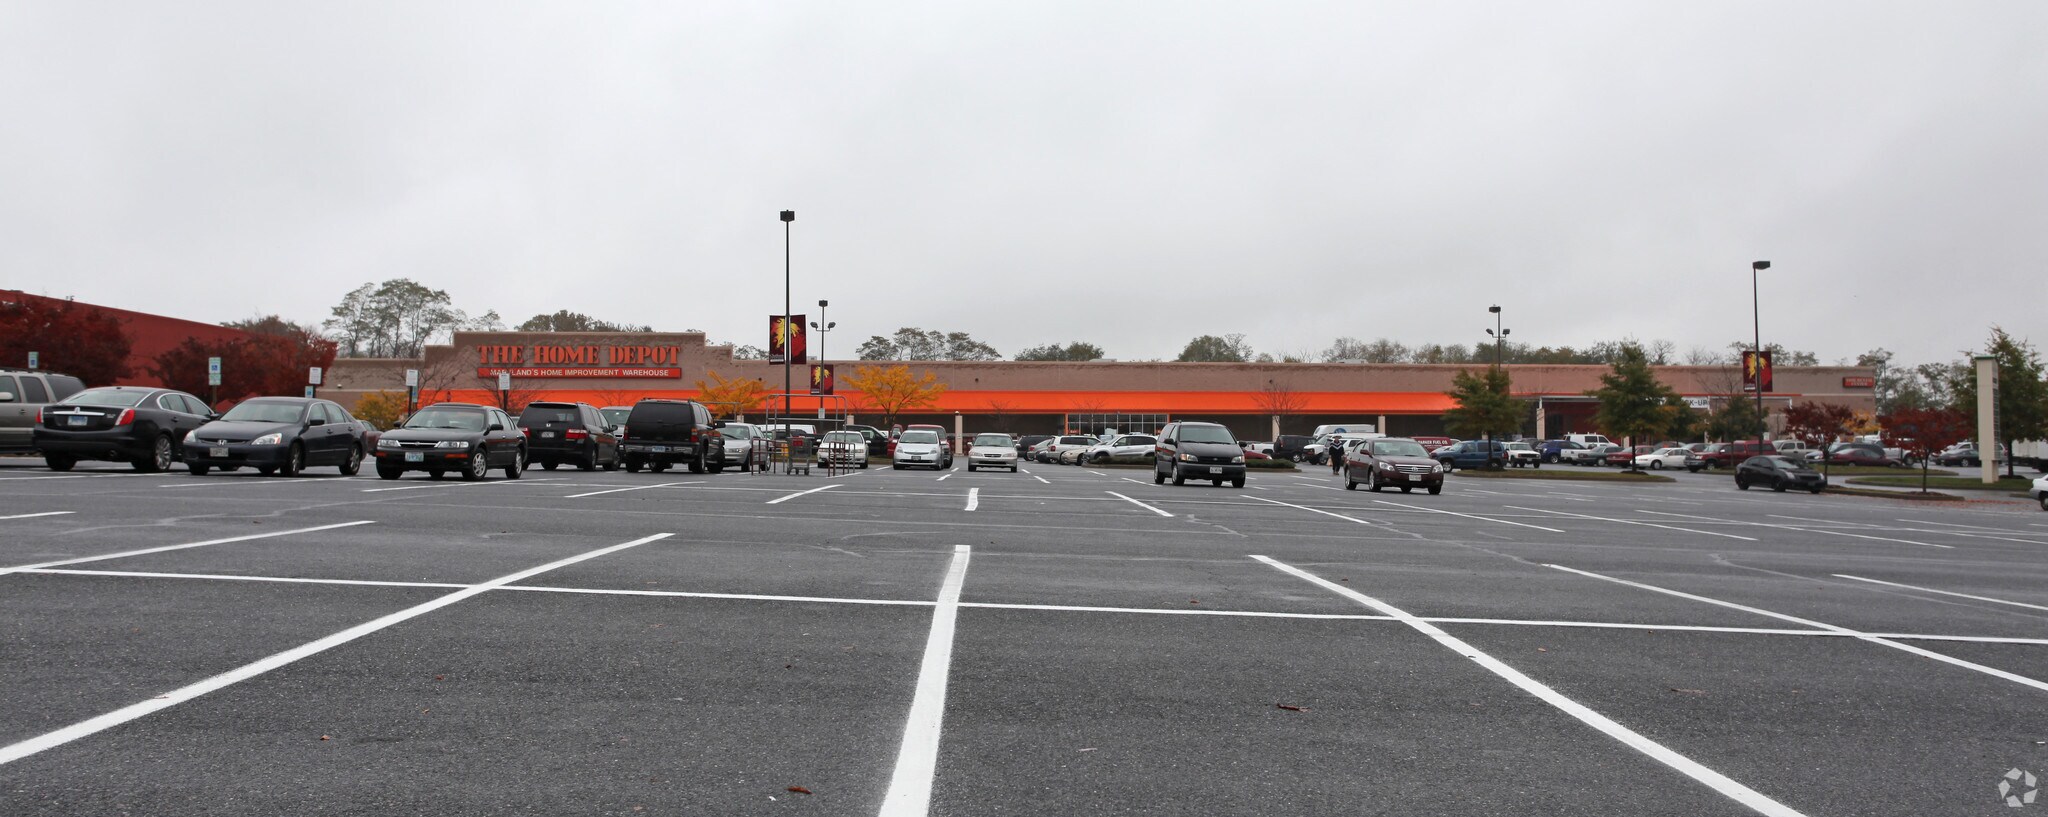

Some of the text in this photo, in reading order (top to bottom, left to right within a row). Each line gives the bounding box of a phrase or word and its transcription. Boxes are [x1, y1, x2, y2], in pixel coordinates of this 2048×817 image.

[477, 345, 681, 364] THE HOME DEPOT
